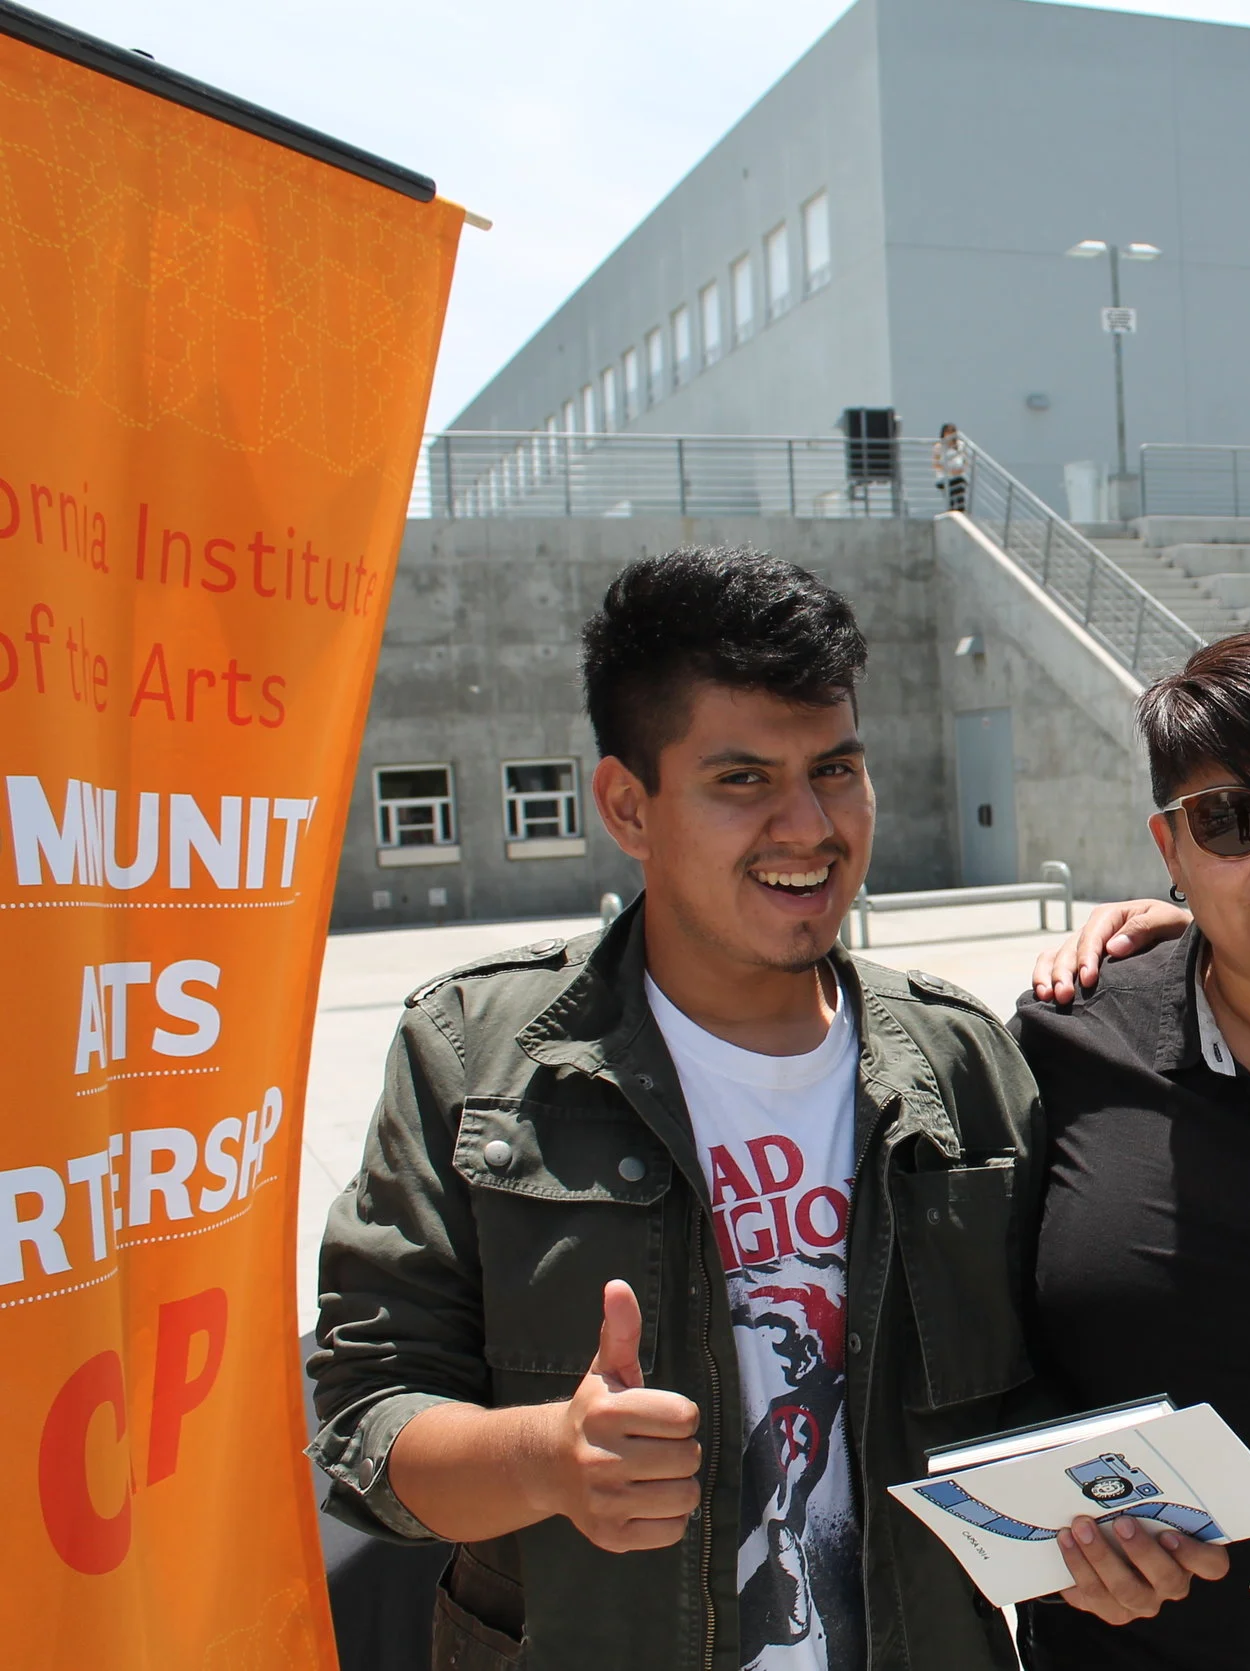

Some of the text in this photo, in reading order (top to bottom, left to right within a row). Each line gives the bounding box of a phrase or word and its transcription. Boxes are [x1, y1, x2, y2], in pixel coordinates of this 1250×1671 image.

[135, 502, 378, 617] Institute
[66, 616, 108, 713] the
[129, 642, 287, 729] Arts
[74, 959, 221, 1075] ATS
[0, 1085, 283, 1286] RTERSHP
[712, 1177, 855, 1273] IGIO
[38, 1287, 228, 1576] CP
